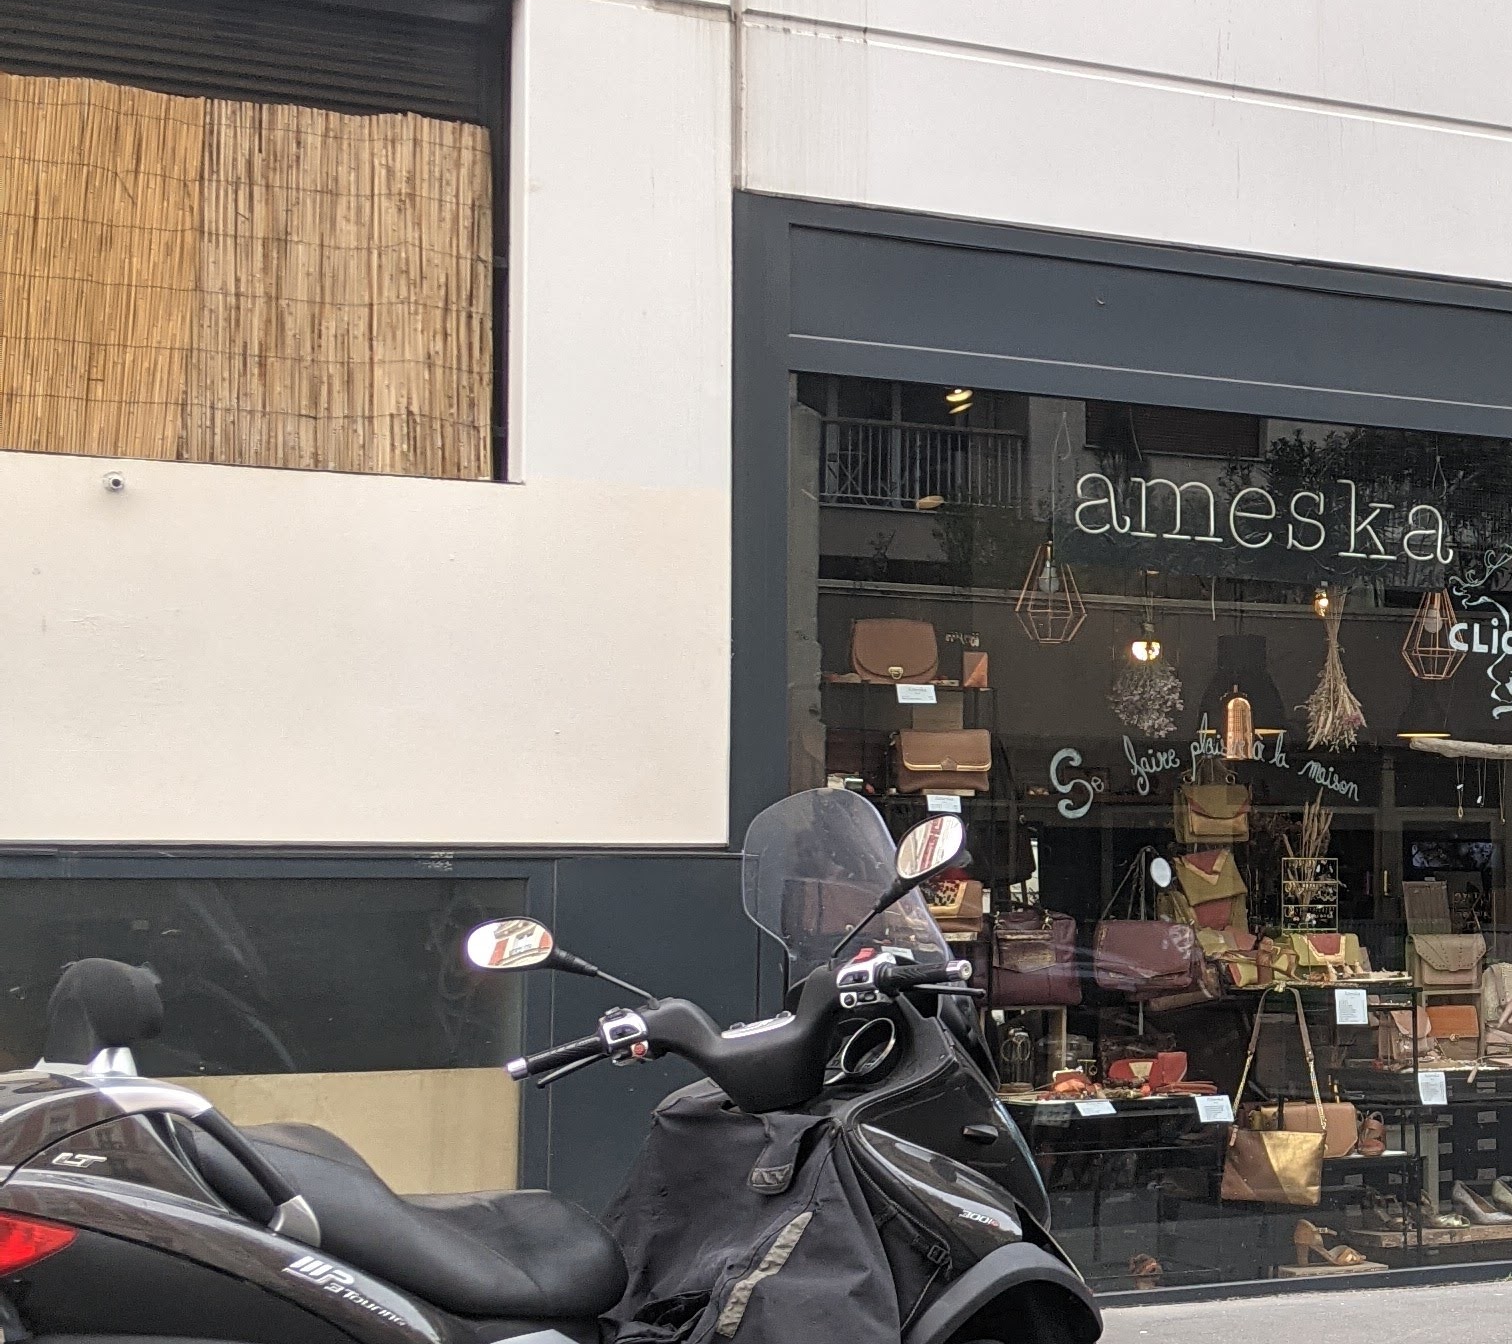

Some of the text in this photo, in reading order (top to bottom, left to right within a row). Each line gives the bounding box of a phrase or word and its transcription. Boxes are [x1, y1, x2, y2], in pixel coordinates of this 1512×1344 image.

[1074, 472, 1455, 565] ameska
[1122, 735, 1180, 796] faire
[1269, 732, 1290, 769] la
[1298, 759, 1359, 802] maison
[51, 1152, 108, 1169] LT
